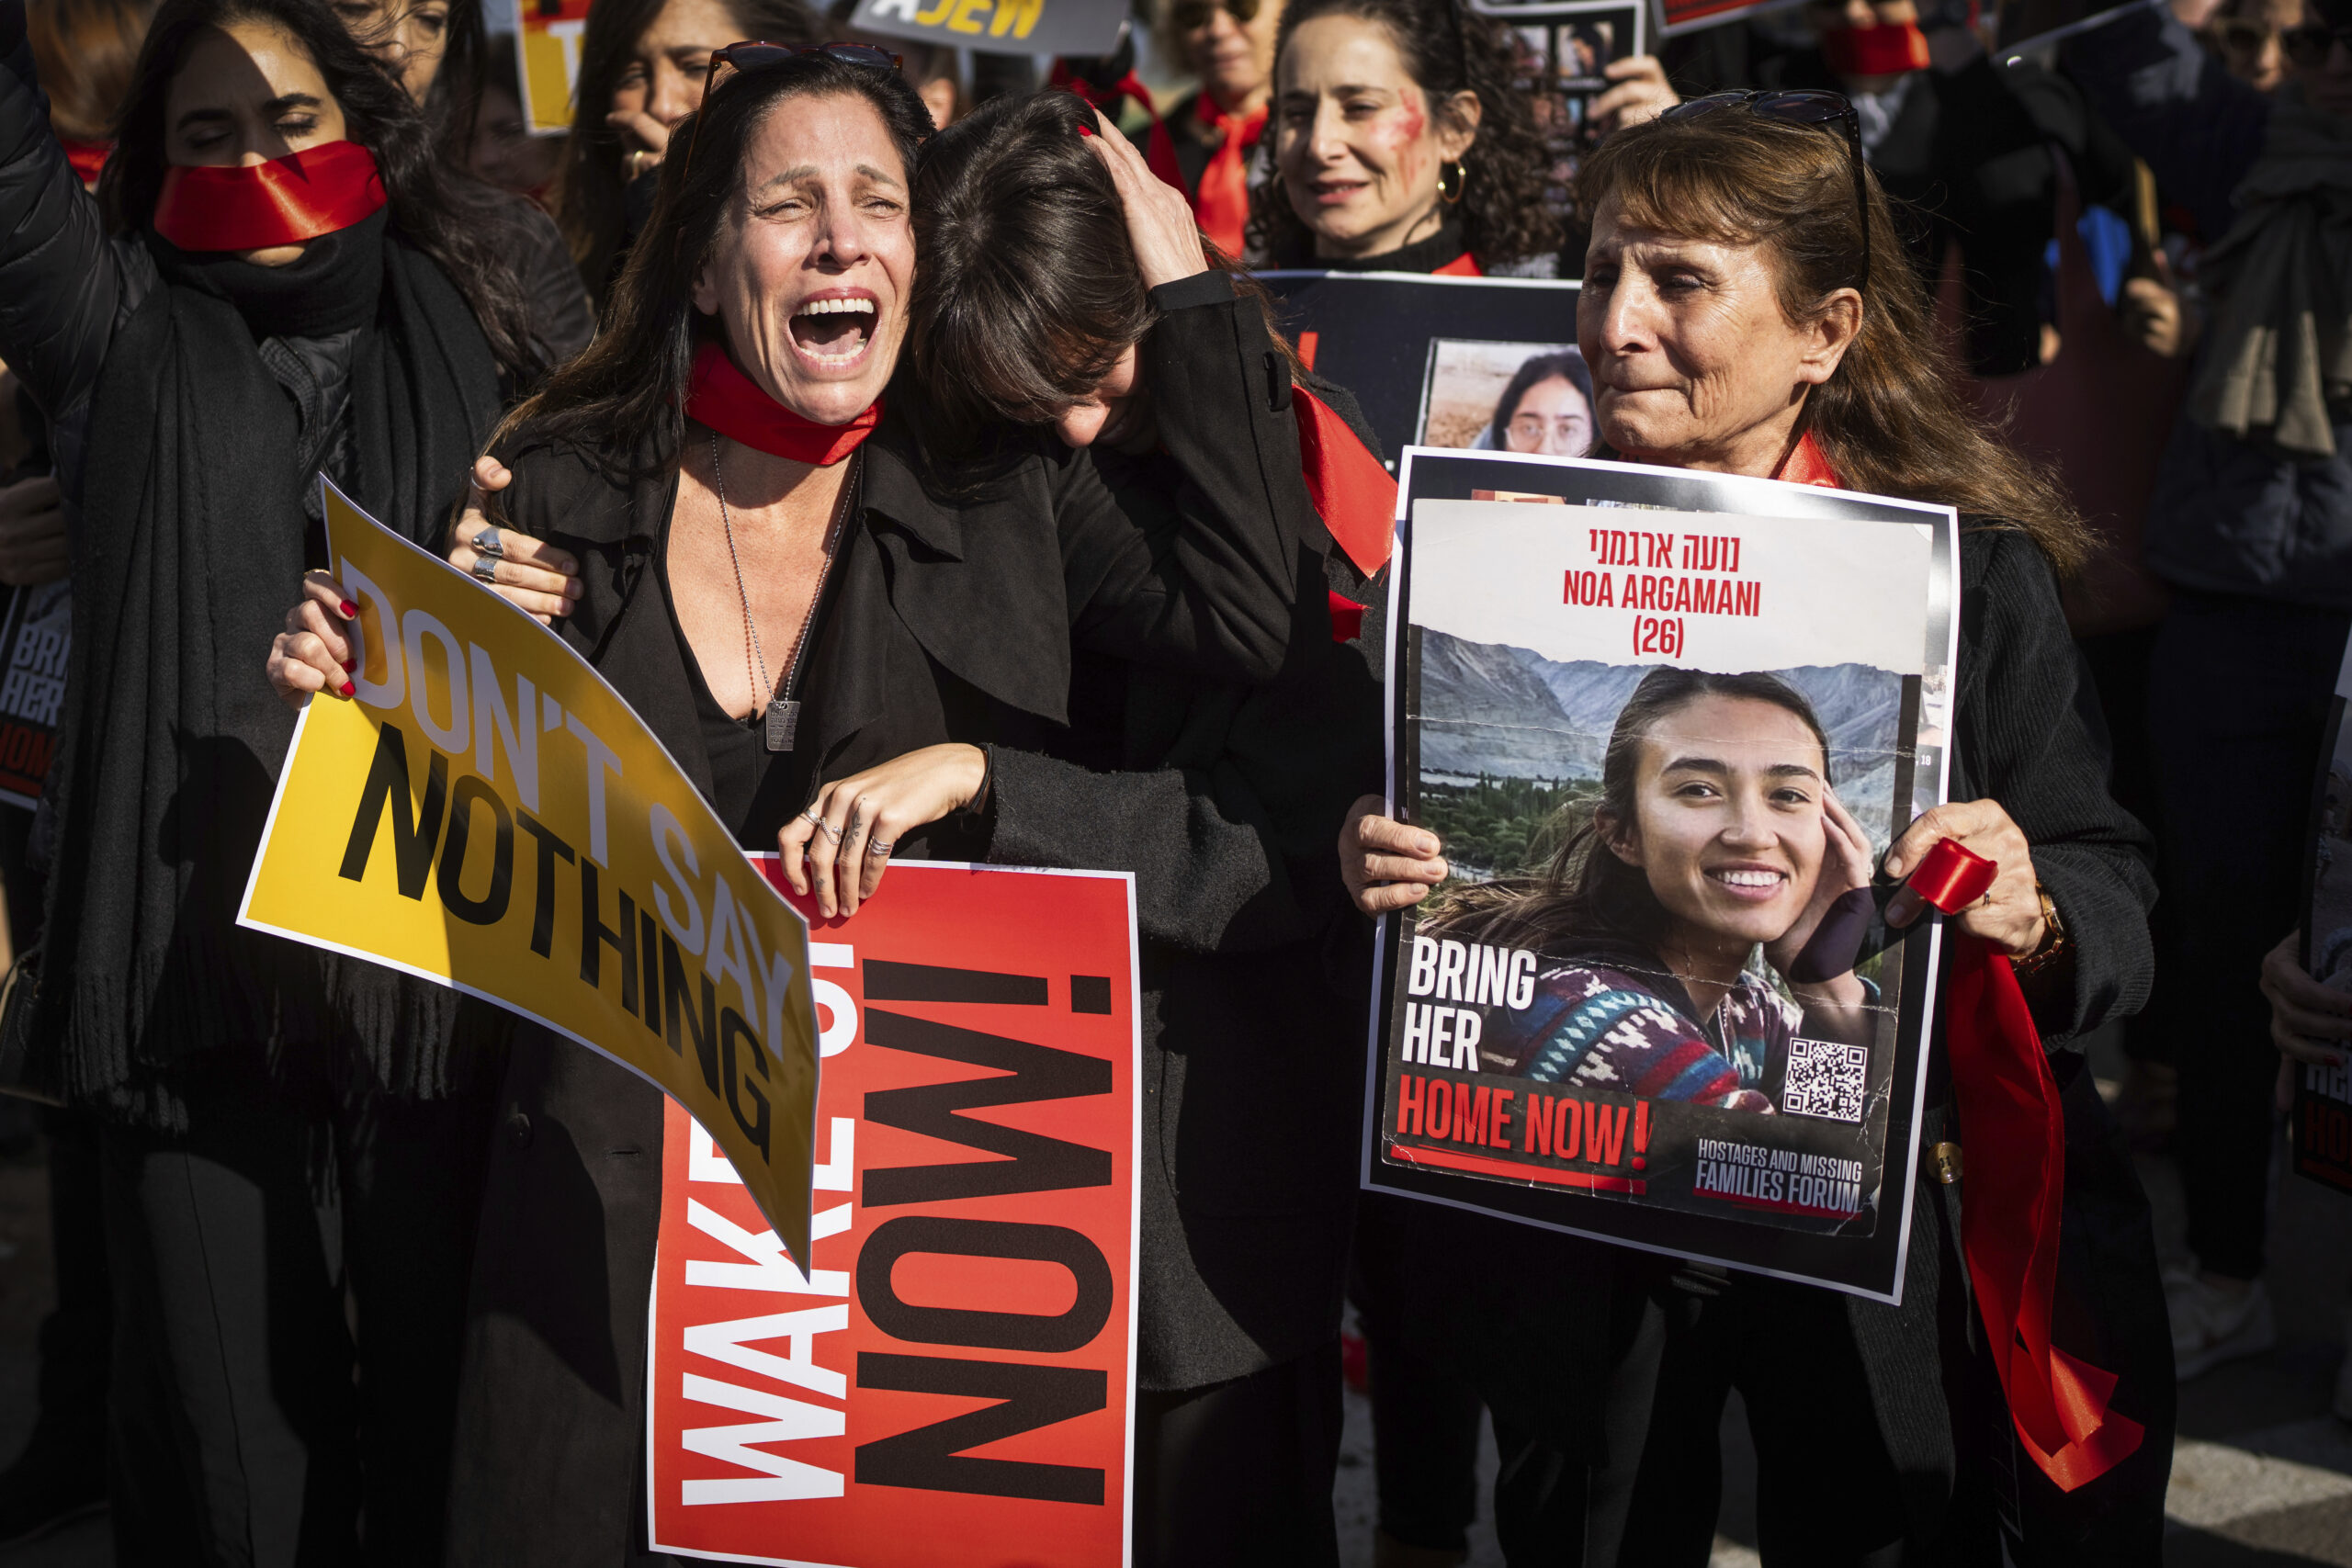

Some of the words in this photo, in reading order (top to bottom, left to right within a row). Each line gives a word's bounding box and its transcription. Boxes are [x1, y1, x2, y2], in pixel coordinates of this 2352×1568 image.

[1589, 529, 1674, 569] ארגמני
[1682, 535, 1740, 572] נועה
[1563, 570, 1613, 607] NOA
[1621, 574, 1761, 617] ARGAMANI
[12, 622, 72, 682] BRI
[1633, 615, 1684, 659] (26)
[0, 669, 65, 727] HER
[340, 554, 623, 870] DON'T
[650, 802, 794, 1063] SAY
[338, 721, 770, 1166] NOTHING
[1408, 935, 1537, 1010] BRING
[1402, 1002, 1482, 1072] HER
[1396, 1074, 1514, 1149] HOME
[1525, 1093, 1653, 1171] NOW!
[2304, 1099, 2352, 1165] HO
[1695, 1159, 1784, 1202] FAMILIES
[1788, 1174, 1860, 1213] FORUM
[1698, 1138, 1767, 1168] HOSTAGES
[1769, 1149, 1797, 1173] AND
[1800, 1154, 1862, 1182] MISSING
[854, 958, 1113, 1506] NOW!
